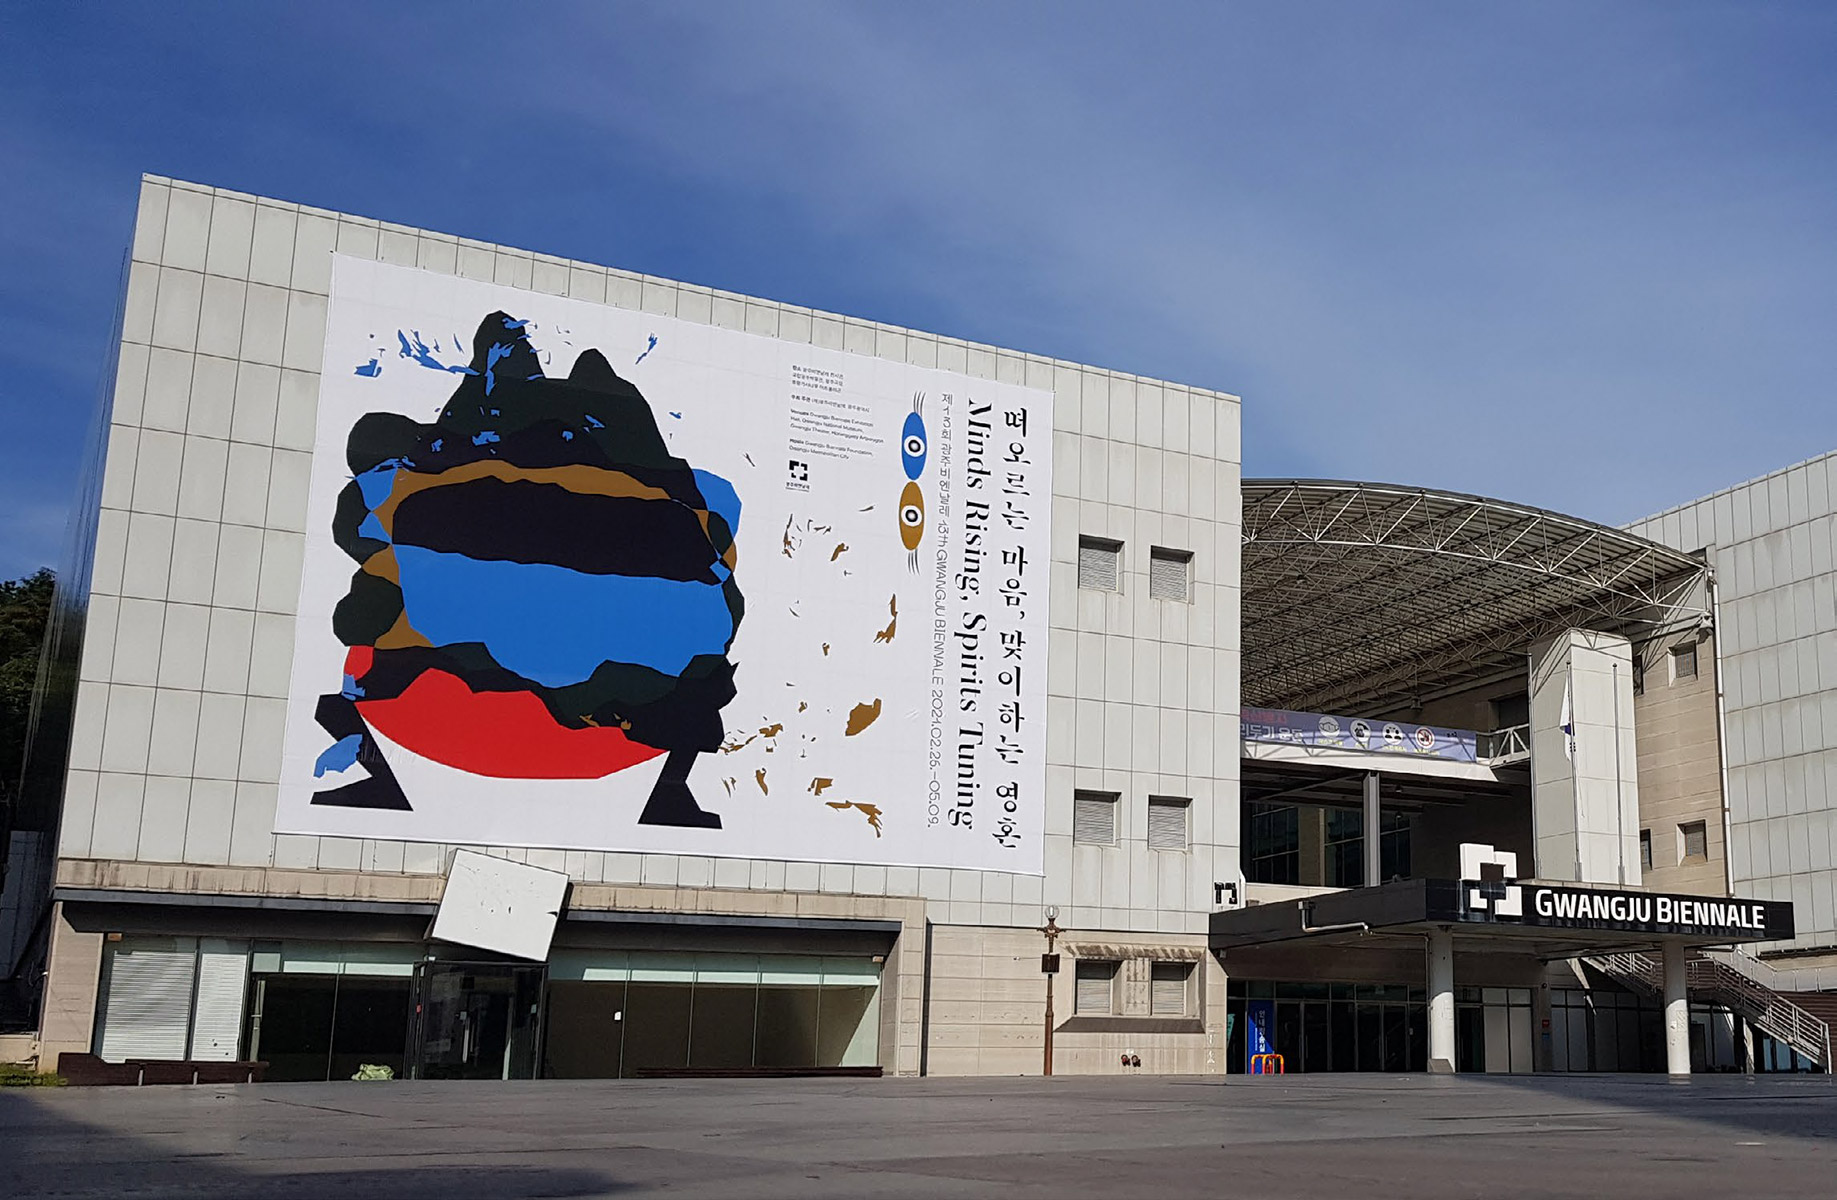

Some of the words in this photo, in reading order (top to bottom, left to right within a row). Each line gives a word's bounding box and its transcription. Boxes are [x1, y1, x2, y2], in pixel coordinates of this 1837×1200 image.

[966, 397, 992, 490] Minds
[1001, 407, 1031, 531] 떠오르는
[934, 549, 948, 616] GWANGJU
[954, 498, 990, 601] Rising,
[998, 545, 1029, 620] 마음,
[931, 619, 947, 686] BIENNALE
[953, 611, 988, 712] Spirits
[994, 629, 1027, 765] 맞이하는
[947, 721, 984, 830] Tuning
[991, 781, 1022, 849] 영혼
[1534, 889, 1652, 923] GWANGJU
[1656, 896, 1766, 930] BIENNALE
